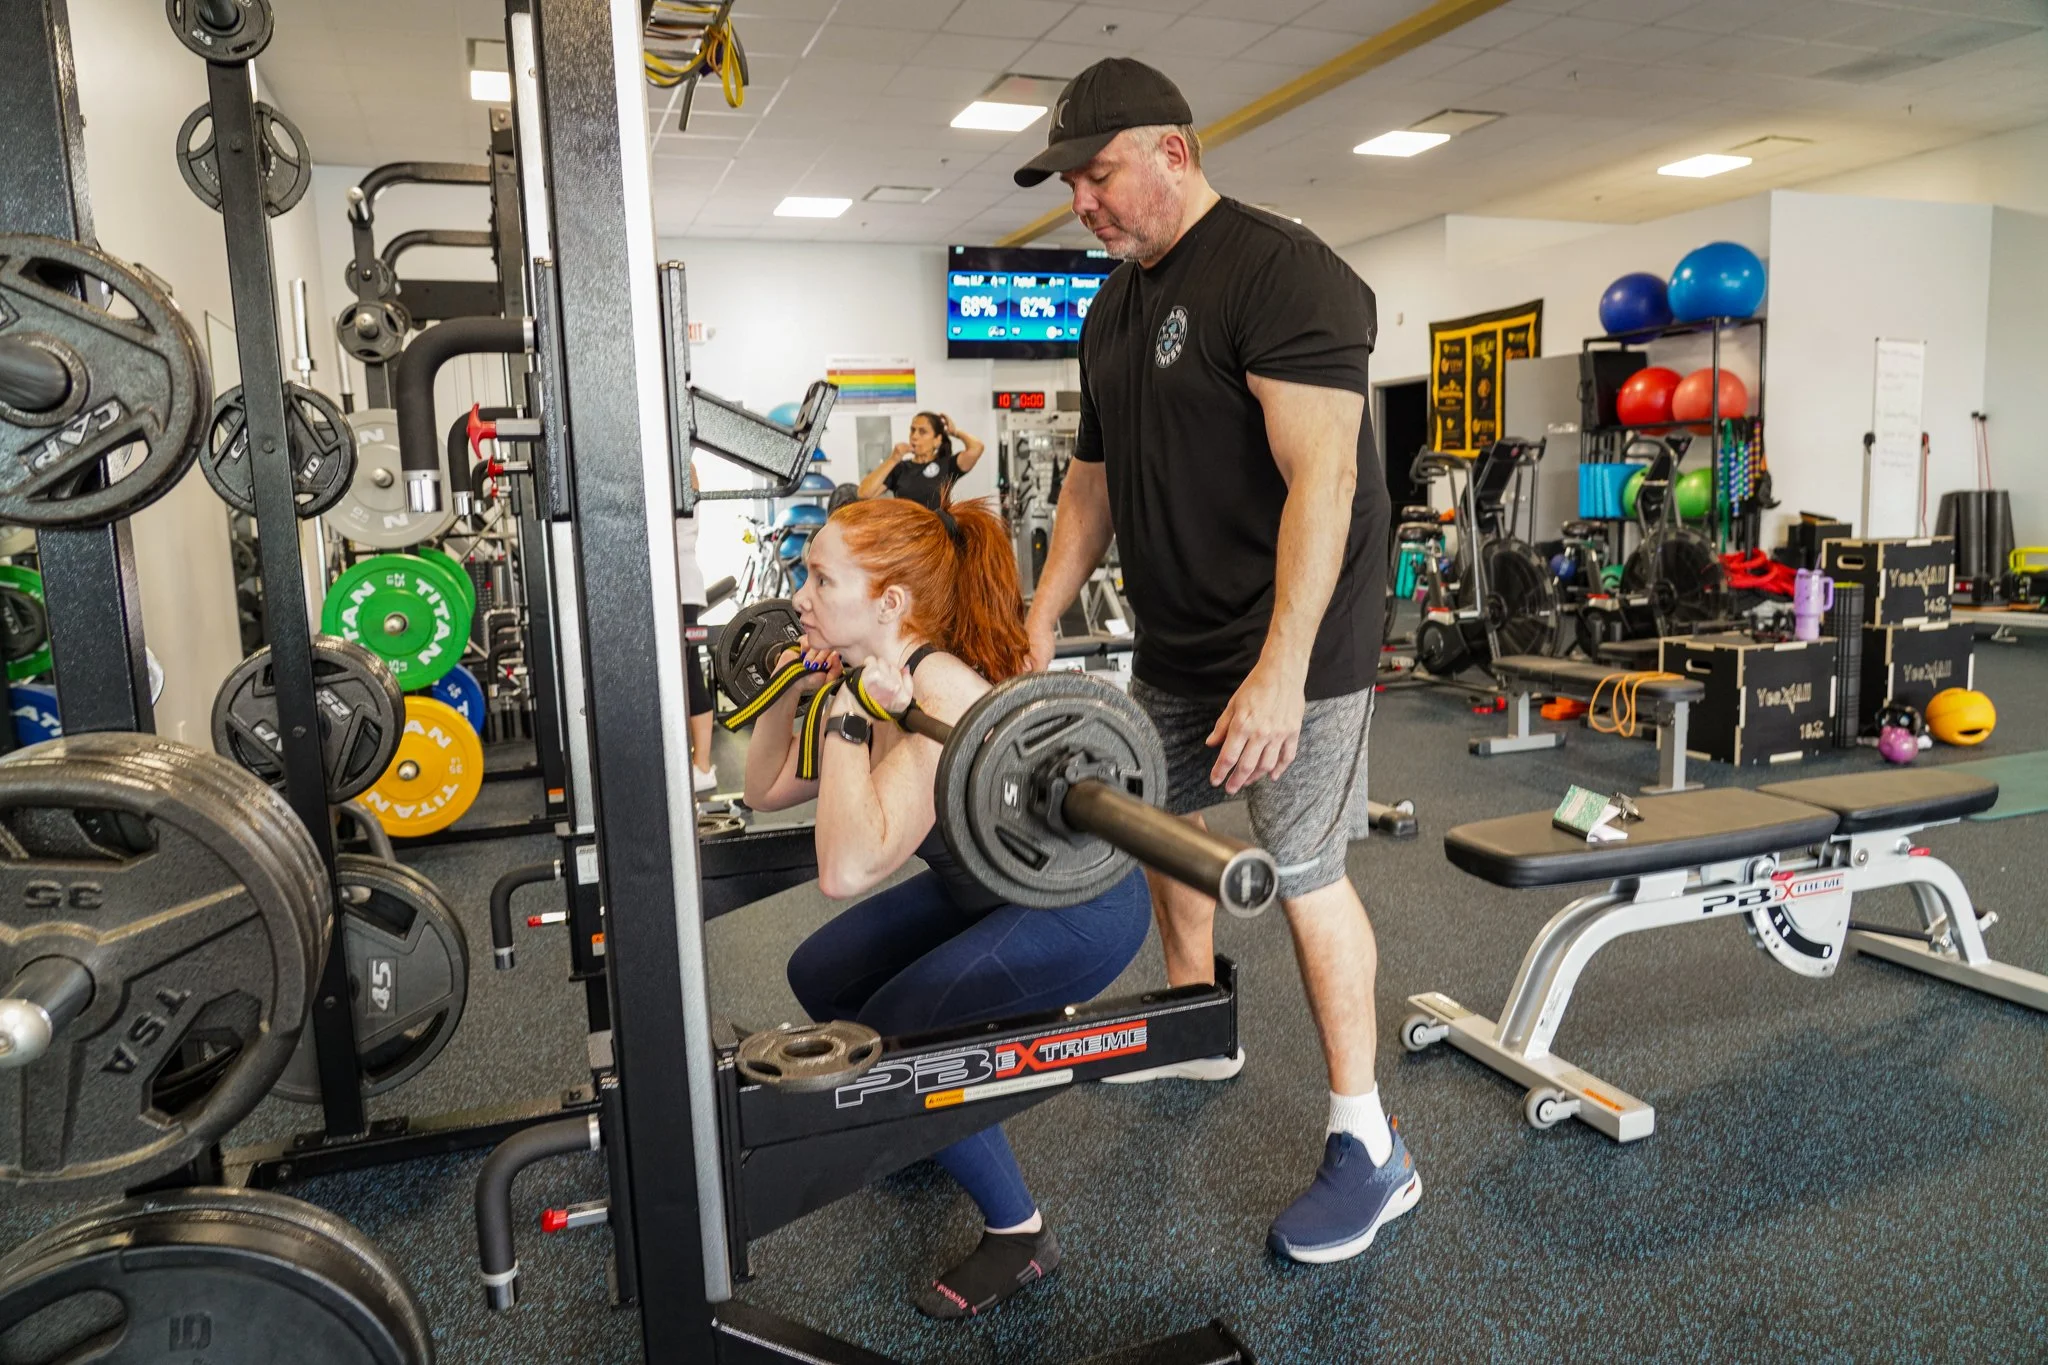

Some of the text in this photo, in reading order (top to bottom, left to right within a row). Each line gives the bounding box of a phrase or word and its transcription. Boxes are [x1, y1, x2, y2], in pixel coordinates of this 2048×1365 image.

[1020, 297, 1056, 318] 62%
[34, 400, 120, 469] CAP
[303, 457, 320, 479] 10
[342, 581, 376, 642] TAN
[416, 578, 451, 666] TITAN
[366, 783, 459, 818] TITAN
[25, 879, 103, 909] 35
[372, 960, 391, 1011] 45
[996, 1022, 1147, 1078] EXTREME
